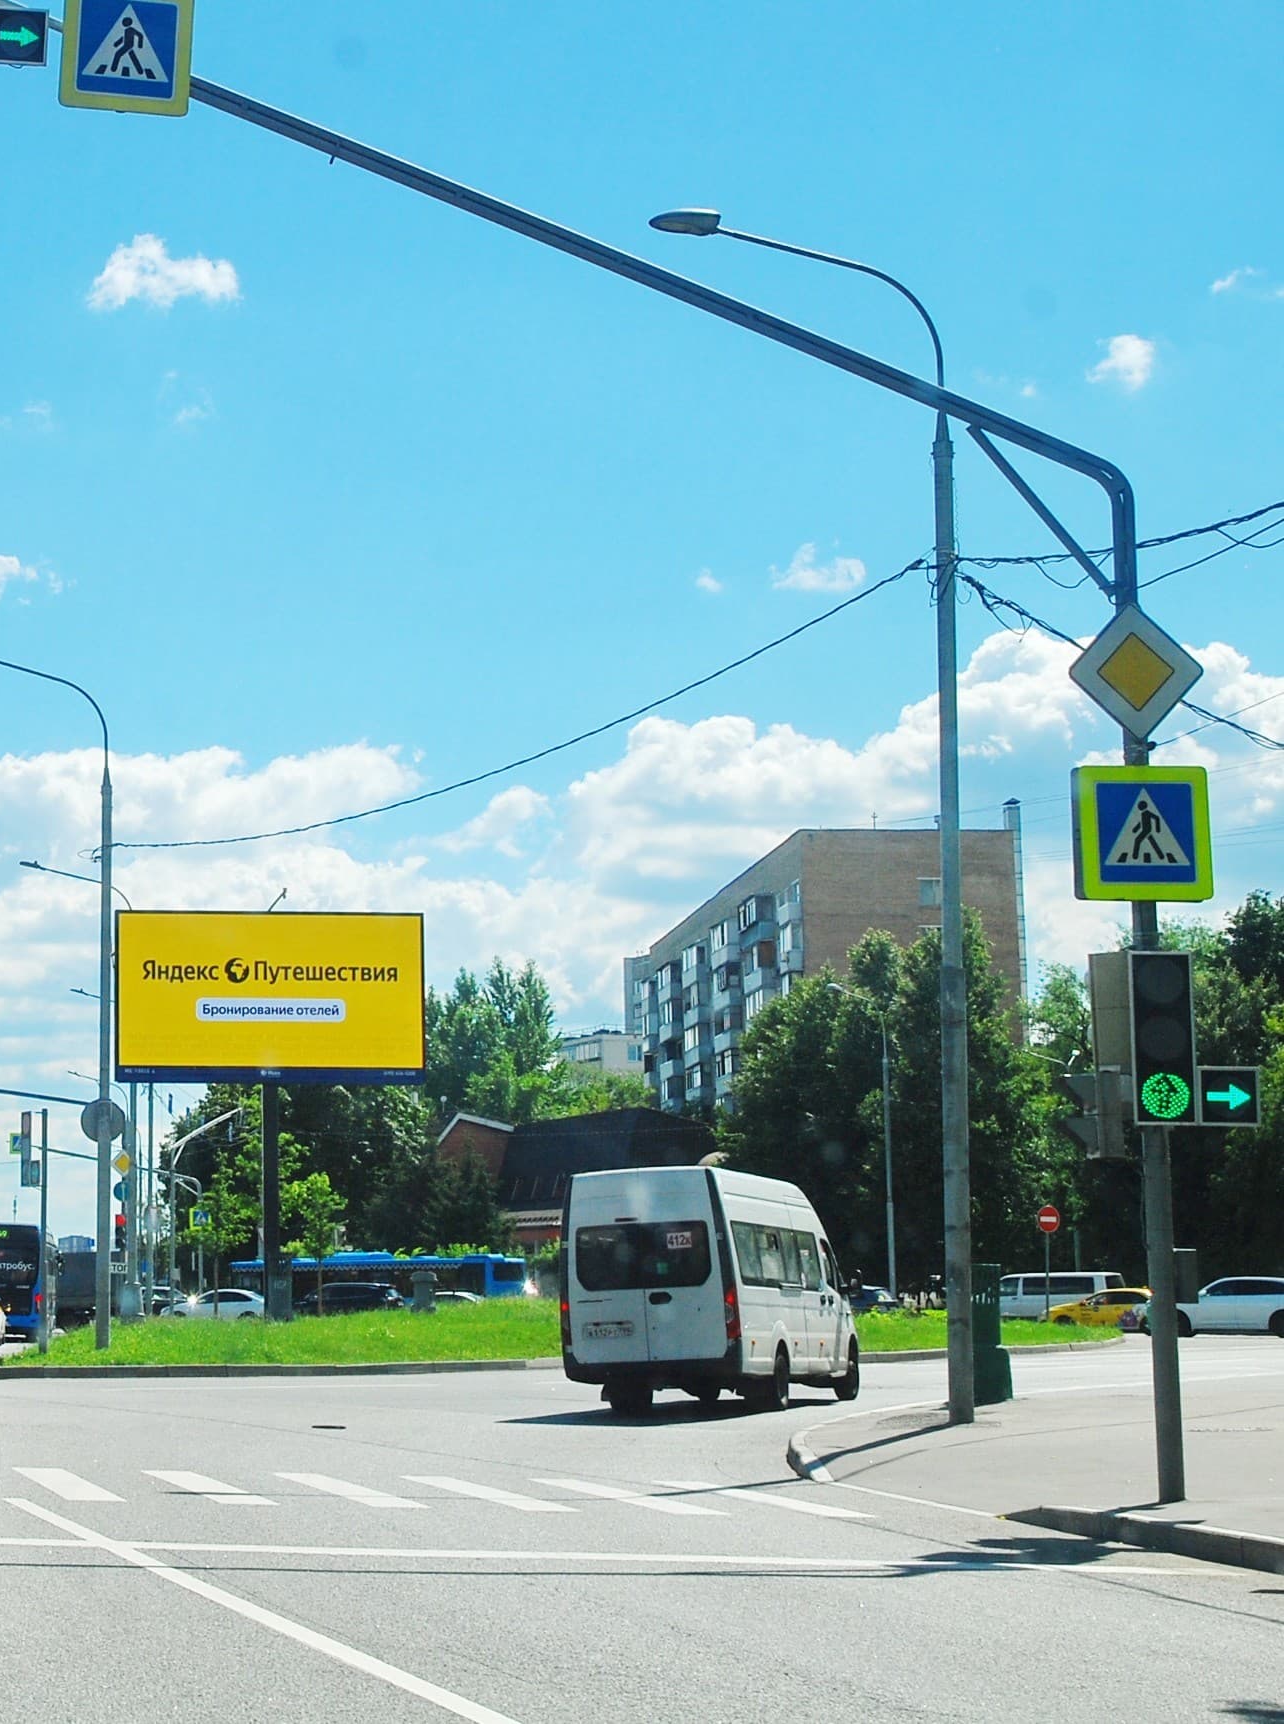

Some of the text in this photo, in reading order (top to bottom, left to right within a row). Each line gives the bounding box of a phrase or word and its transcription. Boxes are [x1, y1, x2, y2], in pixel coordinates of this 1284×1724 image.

[143, 960, 398, 985] Яндекс Путешествия
[202, 1003, 340, 1017] Бронирование отелей
